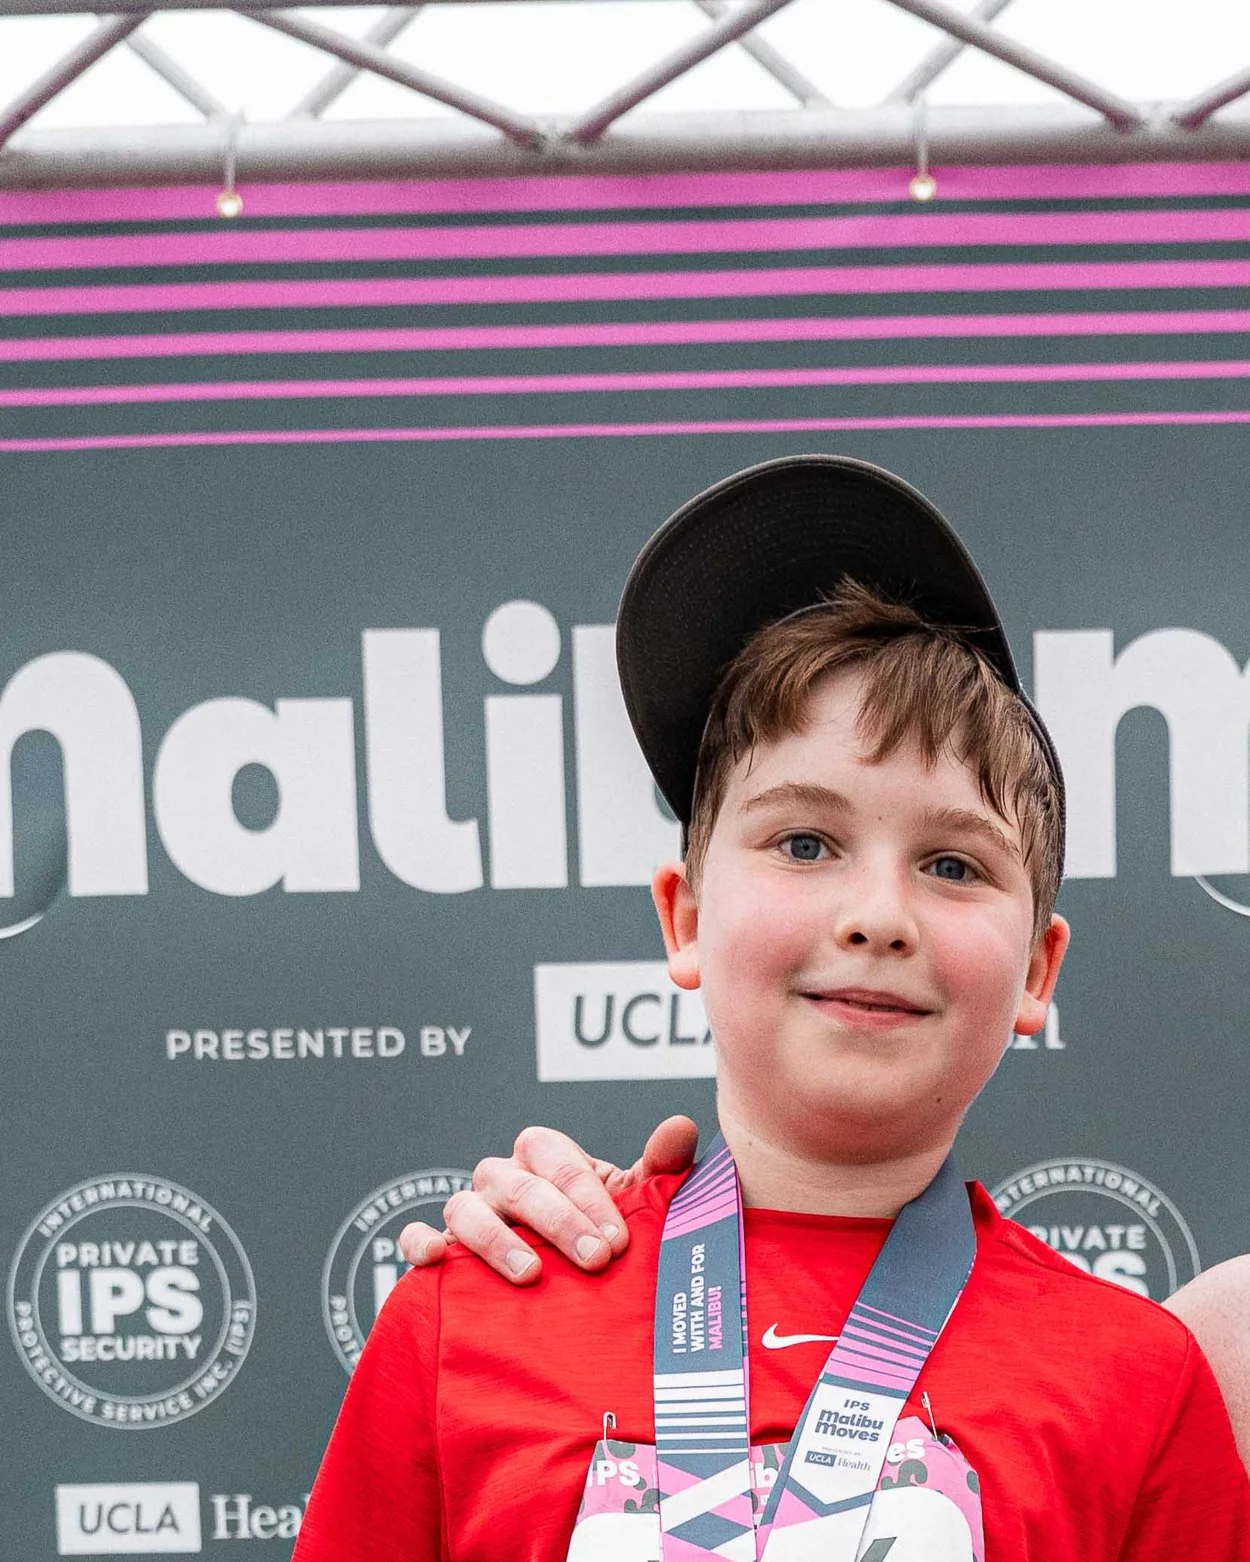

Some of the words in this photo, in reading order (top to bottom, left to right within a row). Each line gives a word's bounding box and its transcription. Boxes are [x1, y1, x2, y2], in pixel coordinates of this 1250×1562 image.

[167, 1027, 405, 1061] PRESENTED
[421, 1025, 472, 1057] BY
[573, 991, 716, 1050] UCL
[37, 1181, 212, 1237] INTERNATIONAL
[996, 1166, 1162, 1218] NTERNATIONAL
[57, 1240, 200, 1267] PRIVATE
[691, 1243, 705, 1273] FOR
[57, 1265, 204, 1336] IPS
[690, 1275, 705, 1307] AND
[672, 1291, 687, 1346] MOVED
[690, 1310, 705, 1353] WITH
[707, 1285, 723, 1350] MALIBU!
[16, 1301, 97, 1414] PROTECTIVE
[102, 1392, 193, 1423] SERVICE
[60, 1336, 202, 1362] SECURITY
[843, 1399, 871, 1411] IPS
[808, 1454, 833, 1464] UCLA
[837, 1457, 871, 1472] Health
[78, 1501, 181, 1536] UCLA
[210, 1493, 303, 1540] Hea
